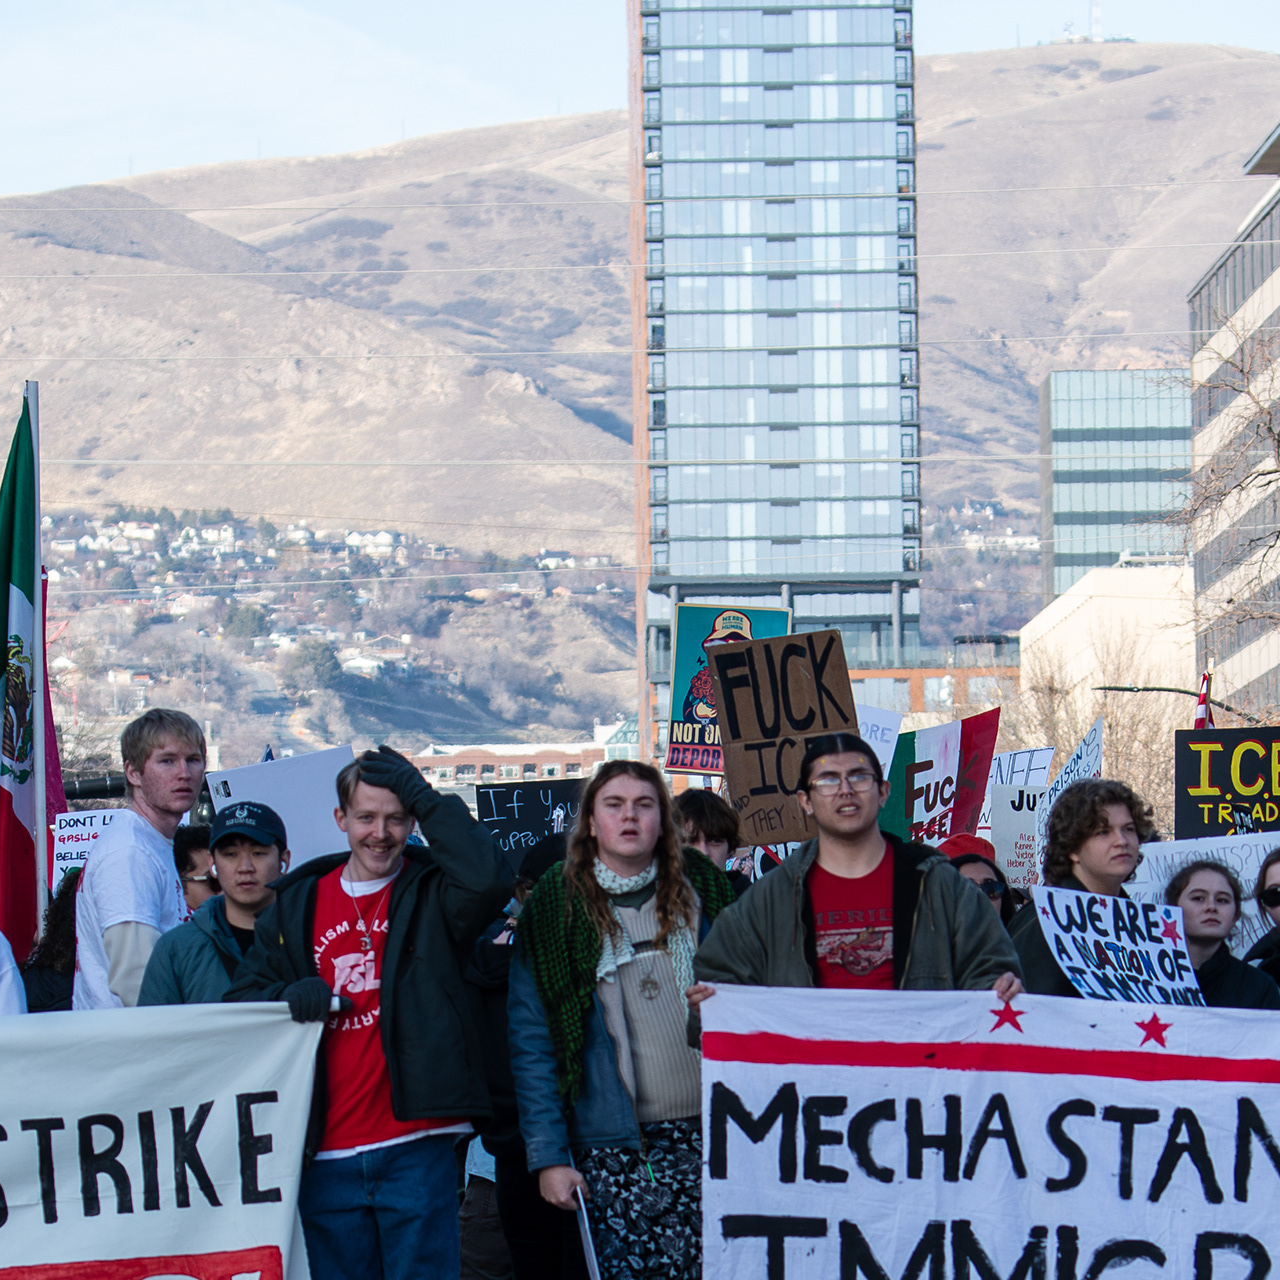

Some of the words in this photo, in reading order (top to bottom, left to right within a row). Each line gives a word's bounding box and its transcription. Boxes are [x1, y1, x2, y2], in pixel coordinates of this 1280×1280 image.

[714, 635, 850, 740] FUCK
[672, 722, 702, 744] NOT
[860, 721, 893, 744] ORE
[670, 747, 720, 770] DEPOR
[744, 737, 815, 797] IC
[1048, 746, 1083, 801] PRISON
[480, 789, 524, 821] If
[1010, 789, 1045, 812] JU
[59, 815, 97, 830] DONT
[745, 804, 785, 836] THEY
[58, 832, 100, 845] GASLIG
[1020, 833, 1036, 842] Alex
[55, 851, 90, 861] BELIE
[1047, 891, 1110, 938] WE
[1112, 897, 1165, 947] ARE
[331, 950, 381, 996] PSL
[1054, 933, 1073, 962] A
[1071, 935, 1161, 982] NATION
[1157, 948, 1192, 983] OF
[709, 1081, 1027, 1183] MECHA
